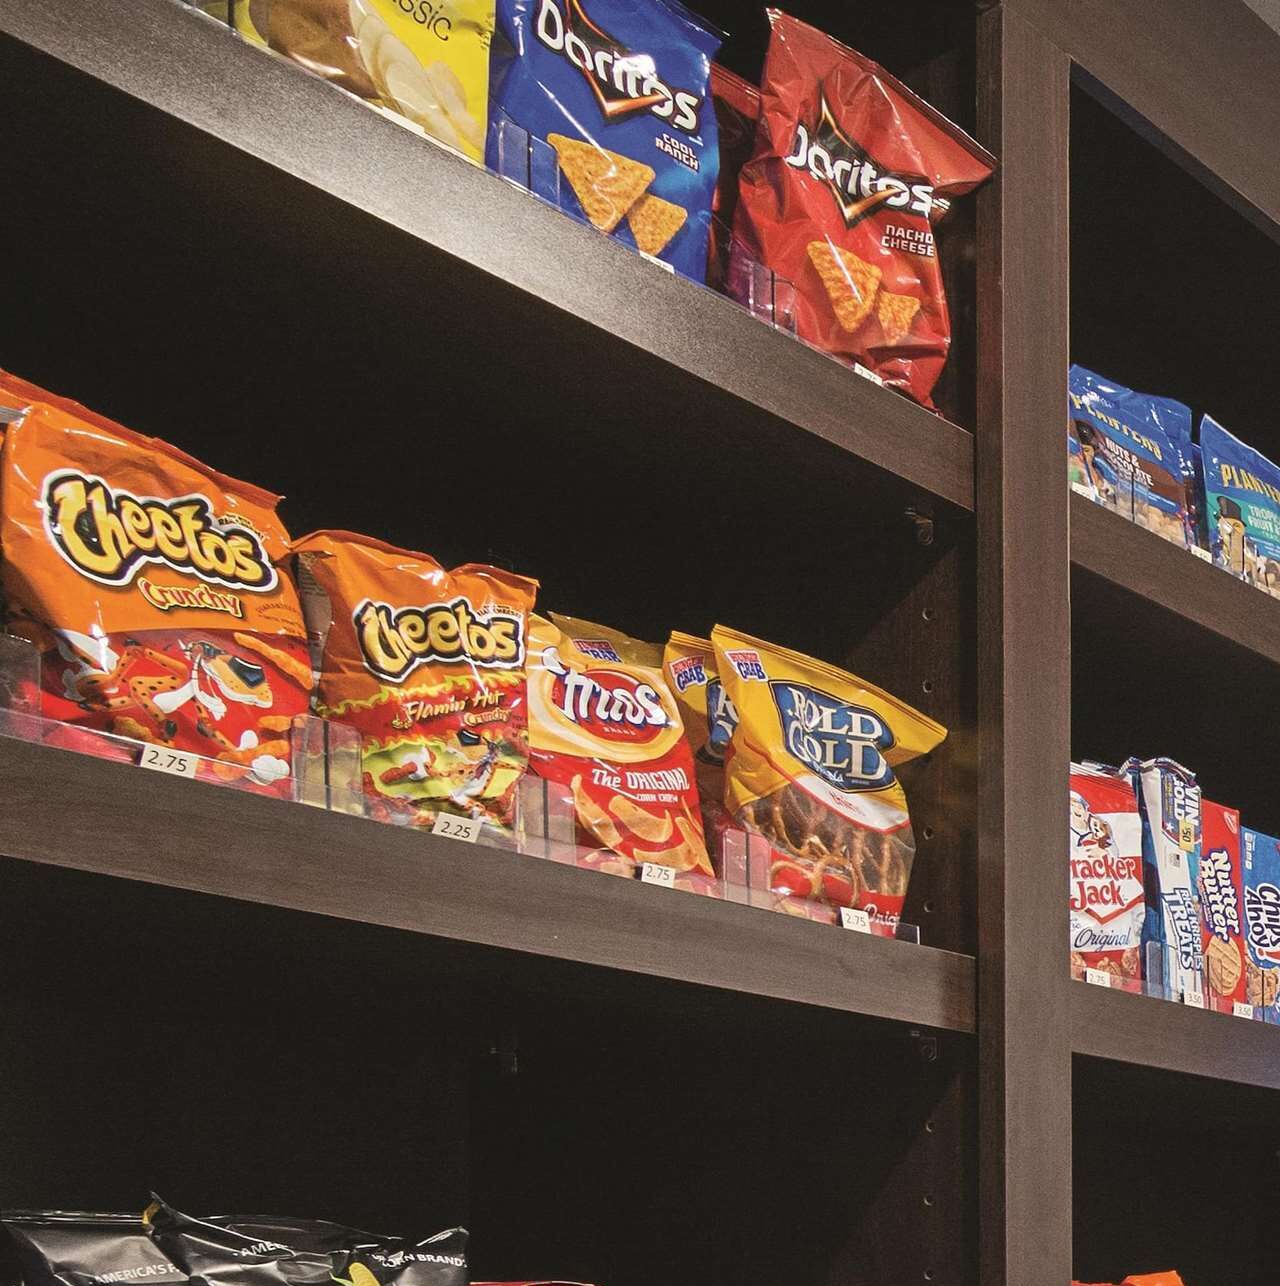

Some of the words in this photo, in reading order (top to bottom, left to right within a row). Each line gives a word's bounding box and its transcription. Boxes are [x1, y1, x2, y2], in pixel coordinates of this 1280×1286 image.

[536, 0, 699, 131] Doritos
[656, 140, 698, 171] RANCH
[662, 133, 697, 158] COOL
[881, 236, 934, 257] CHEESE
[886, 224, 934, 243] NACHO
[53, 480, 265, 583] Cheetos
[138, 577, 243, 618] Crunchy
[360, 602, 518, 675] Cheetos
[736, 660, 766, 680] GRAB
[147, 749, 188, 772] 2.75
[789, 719, 888, 781] GOLD
[592, 768, 621, 788] The
[626, 767, 690, 791] ORIGINAL
[441, 821, 472, 839] 2.25
[646, 866, 670, 881] 2.75
[1071, 880, 1125, 911] Jack
[1202, 857, 1230, 942] Butter
[1211, 850, 1239, 937] Nutter
[845, 912, 866, 927] 2.75
[1164, 891, 1194, 971] TREATS
[1074, 927, 1132, 951] Original
